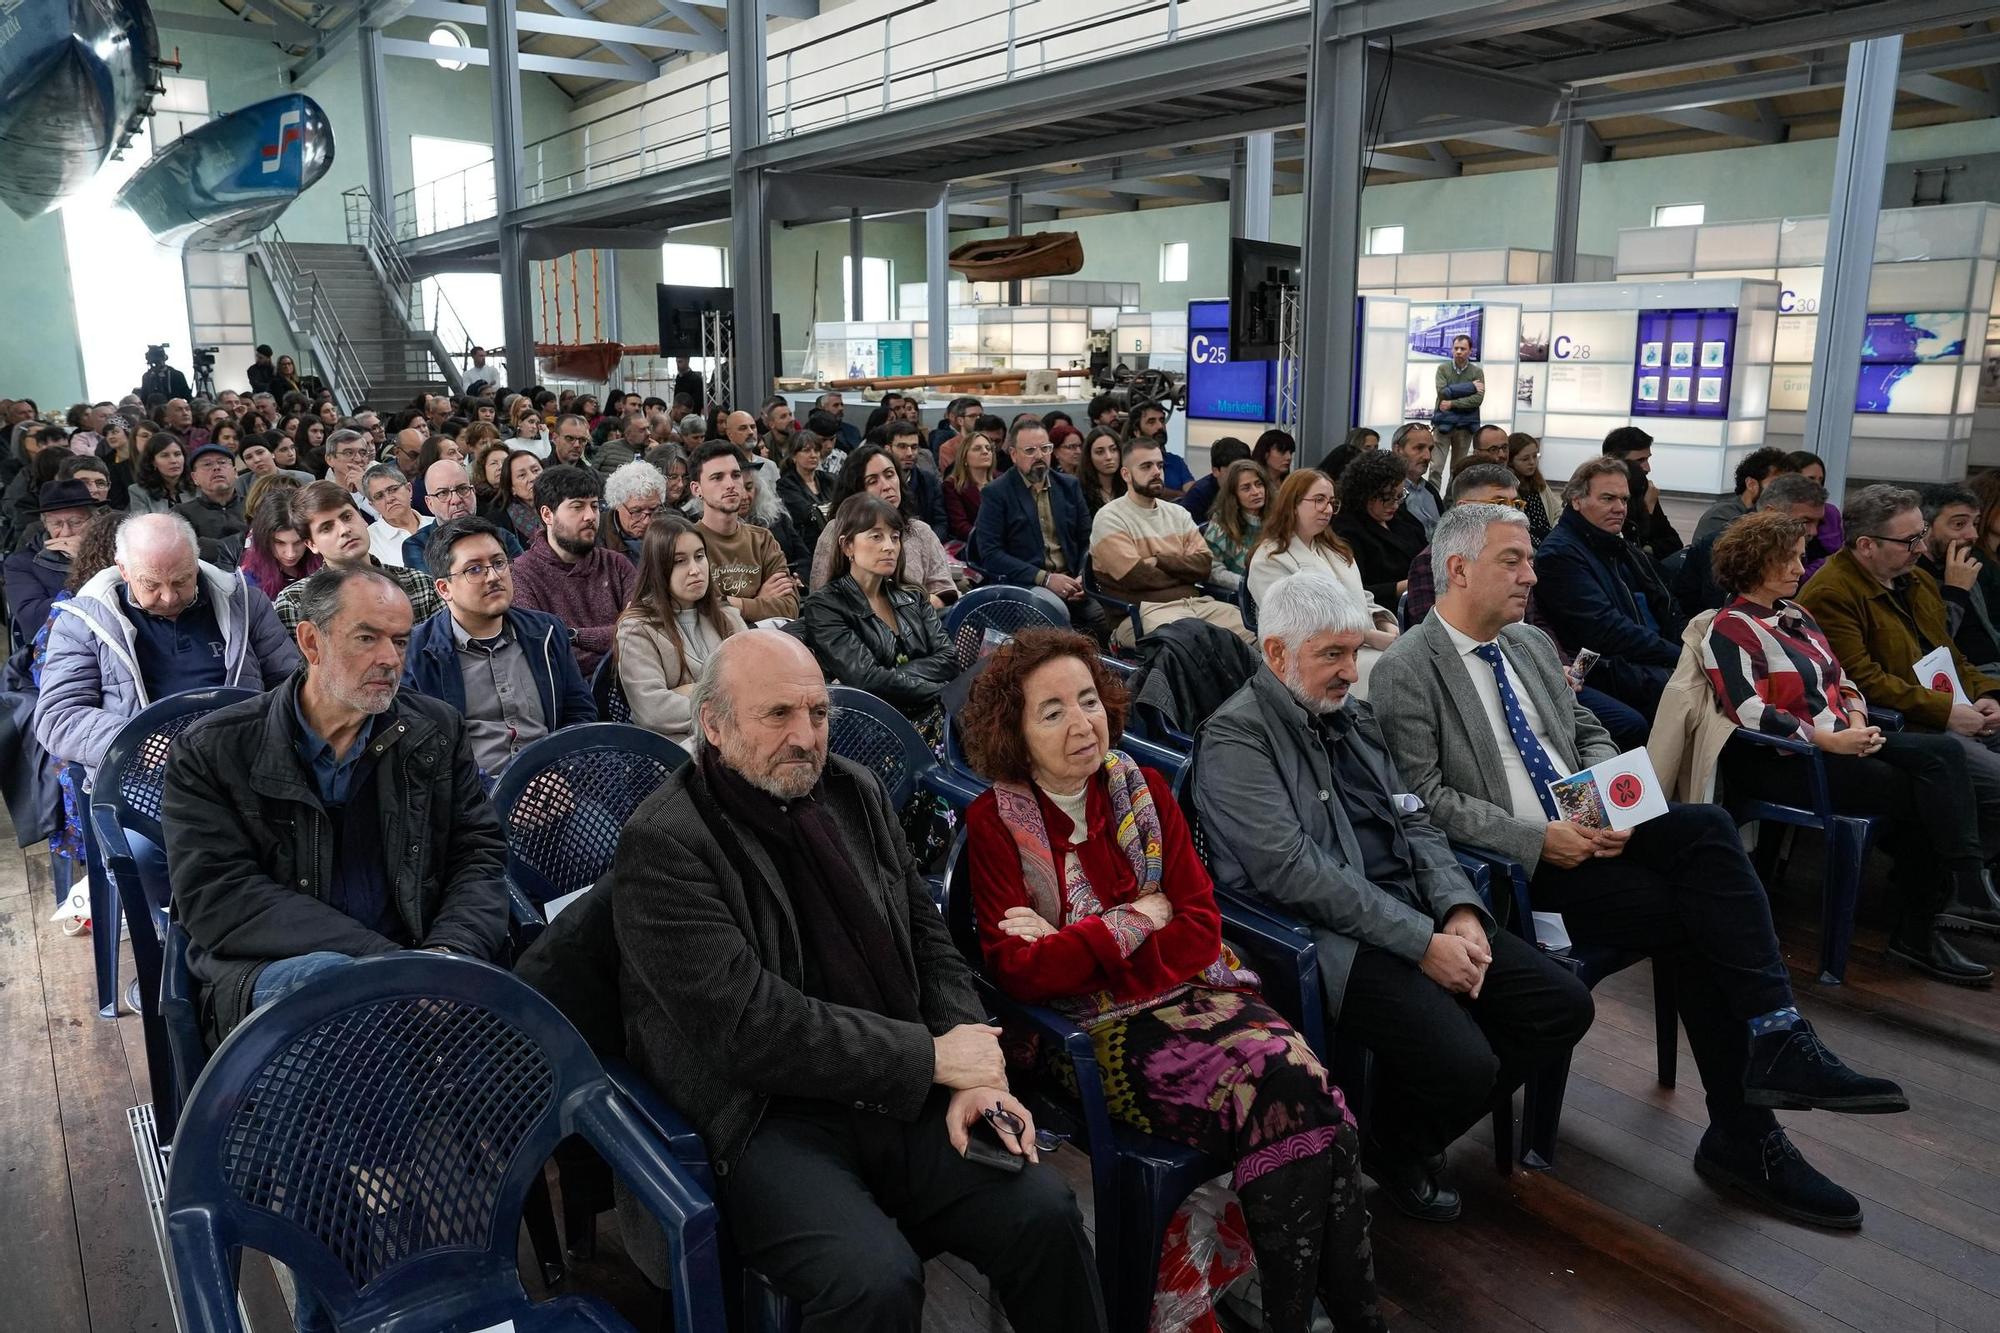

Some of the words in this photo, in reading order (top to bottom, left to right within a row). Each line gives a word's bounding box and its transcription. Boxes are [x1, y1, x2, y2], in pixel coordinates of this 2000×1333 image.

[1779, 290, 1816, 312] C30
[1191, 335, 1226, 363] C25
[1554, 335, 1591, 359] C28
[1217, 399, 1263, 416] Marketing
